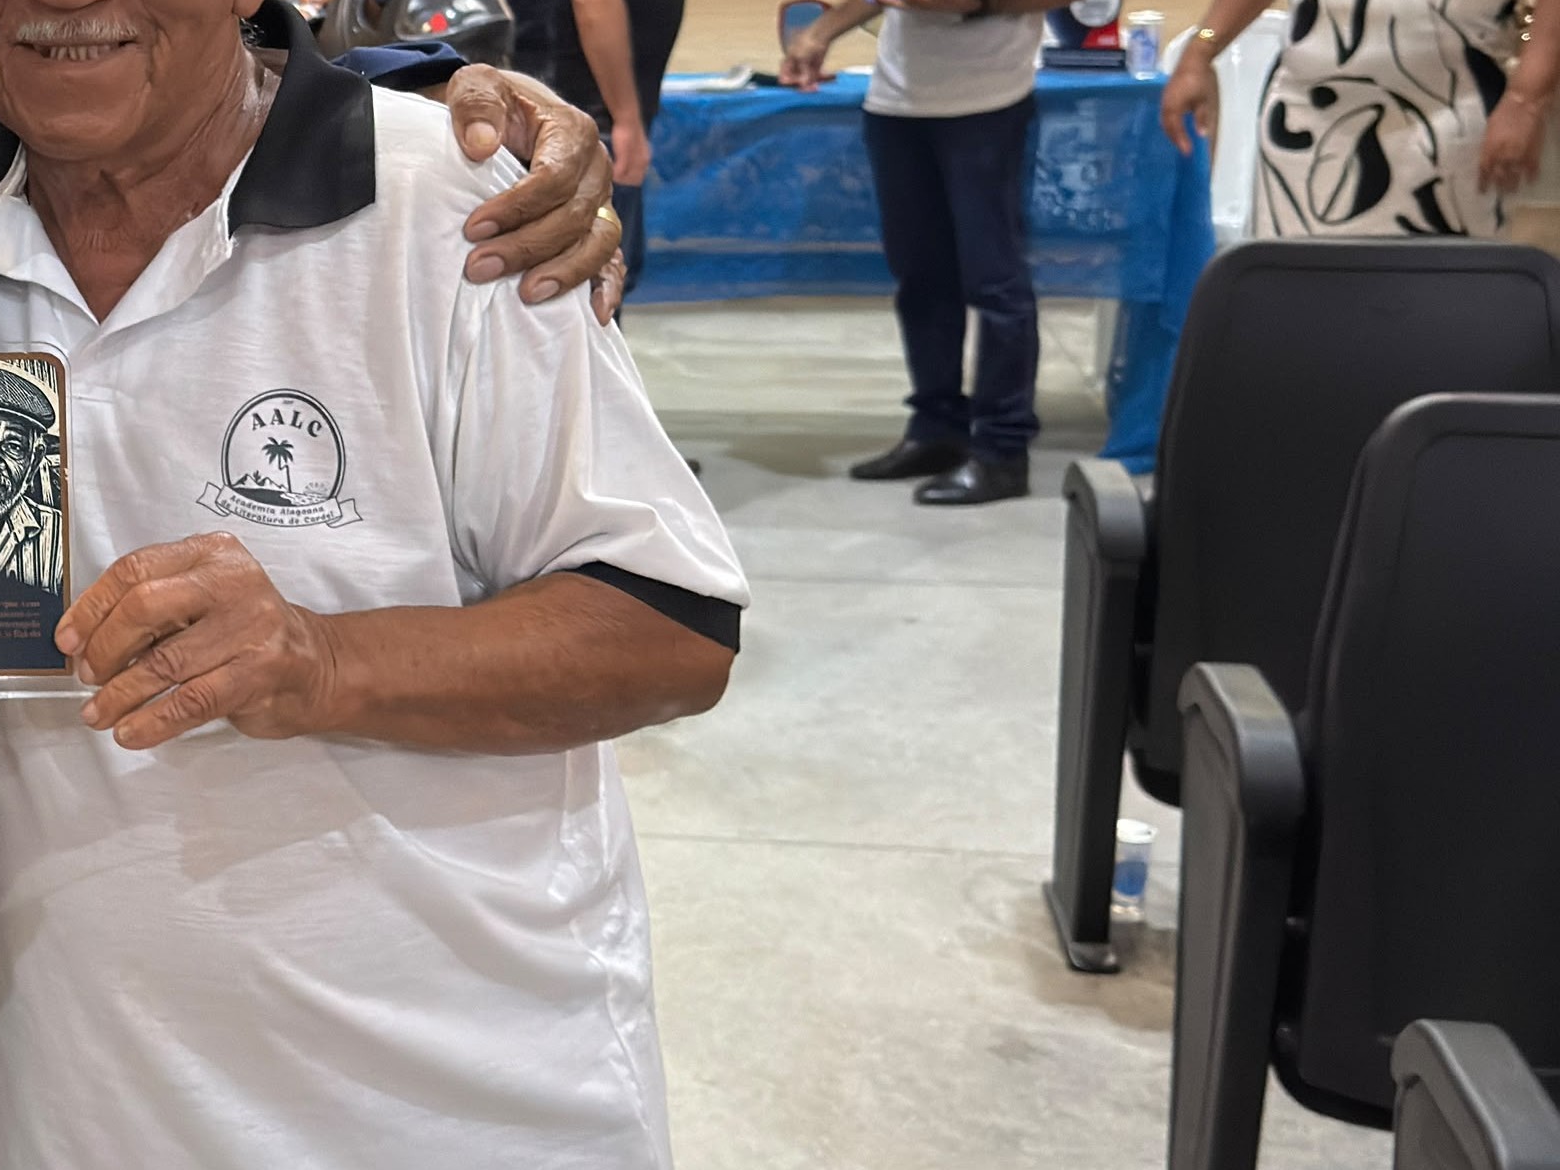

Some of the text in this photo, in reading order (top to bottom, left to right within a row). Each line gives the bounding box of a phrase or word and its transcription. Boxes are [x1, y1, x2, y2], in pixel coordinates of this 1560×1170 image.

[251, 408, 323, 438] AALC
[229, 494, 325, 517] Academia Alagoana
[304, 510, 335, 524] Cordel
